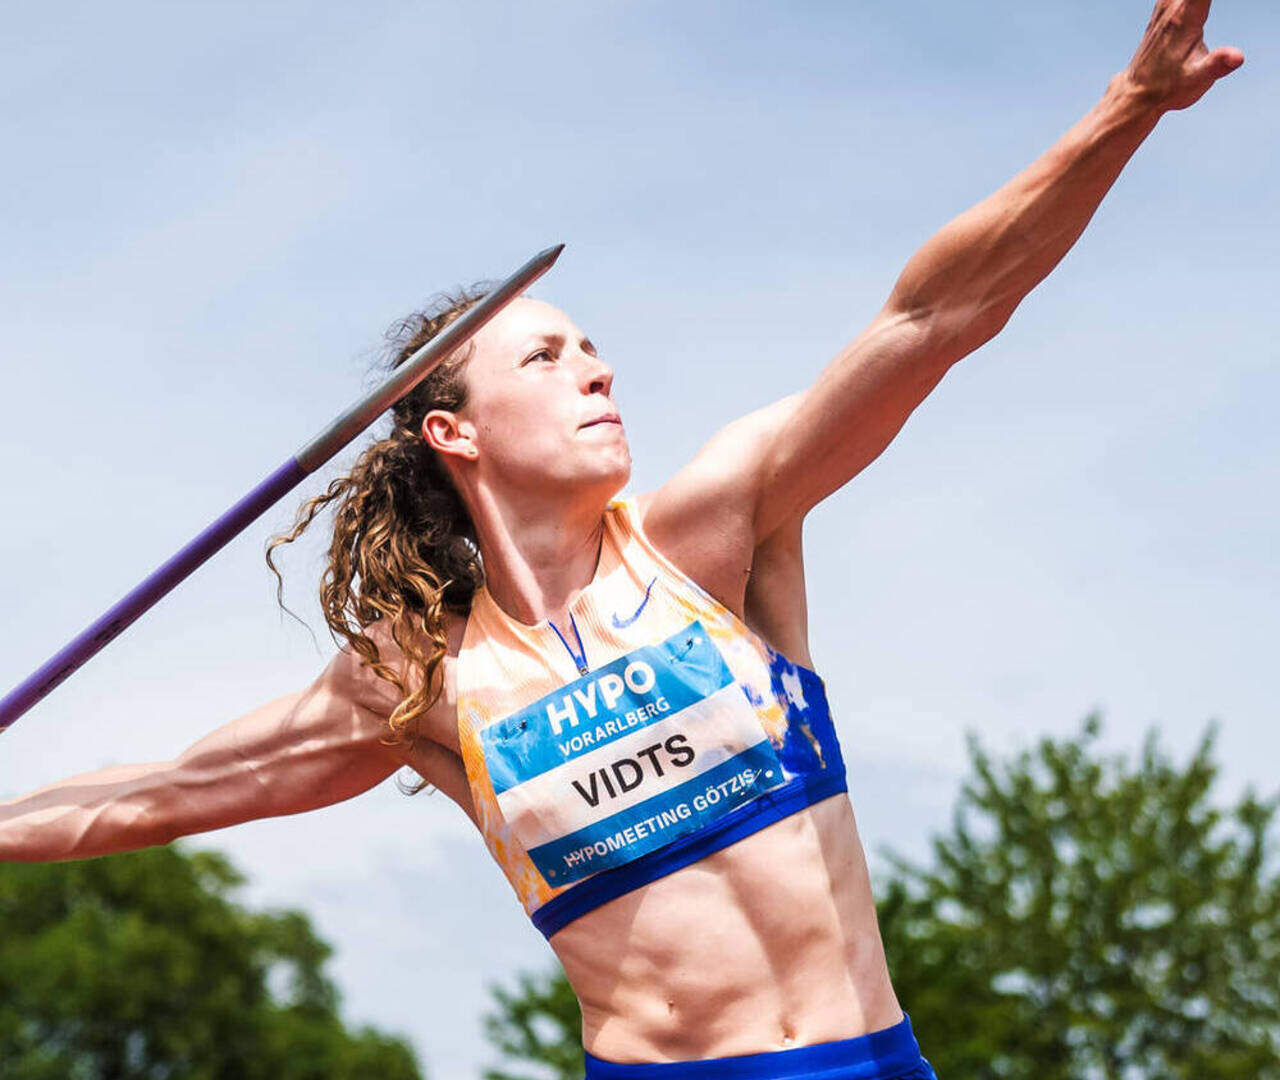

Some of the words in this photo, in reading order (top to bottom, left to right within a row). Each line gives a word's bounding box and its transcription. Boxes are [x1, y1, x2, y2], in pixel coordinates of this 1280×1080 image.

[546, 661, 656, 735] HYPO
[559, 697, 670, 756] VORARLBERG
[571, 734, 695, 807] VIDTS
[563, 804, 692, 867] HYPOMEETING
[693, 768, 755, 811] GÖTZIS
